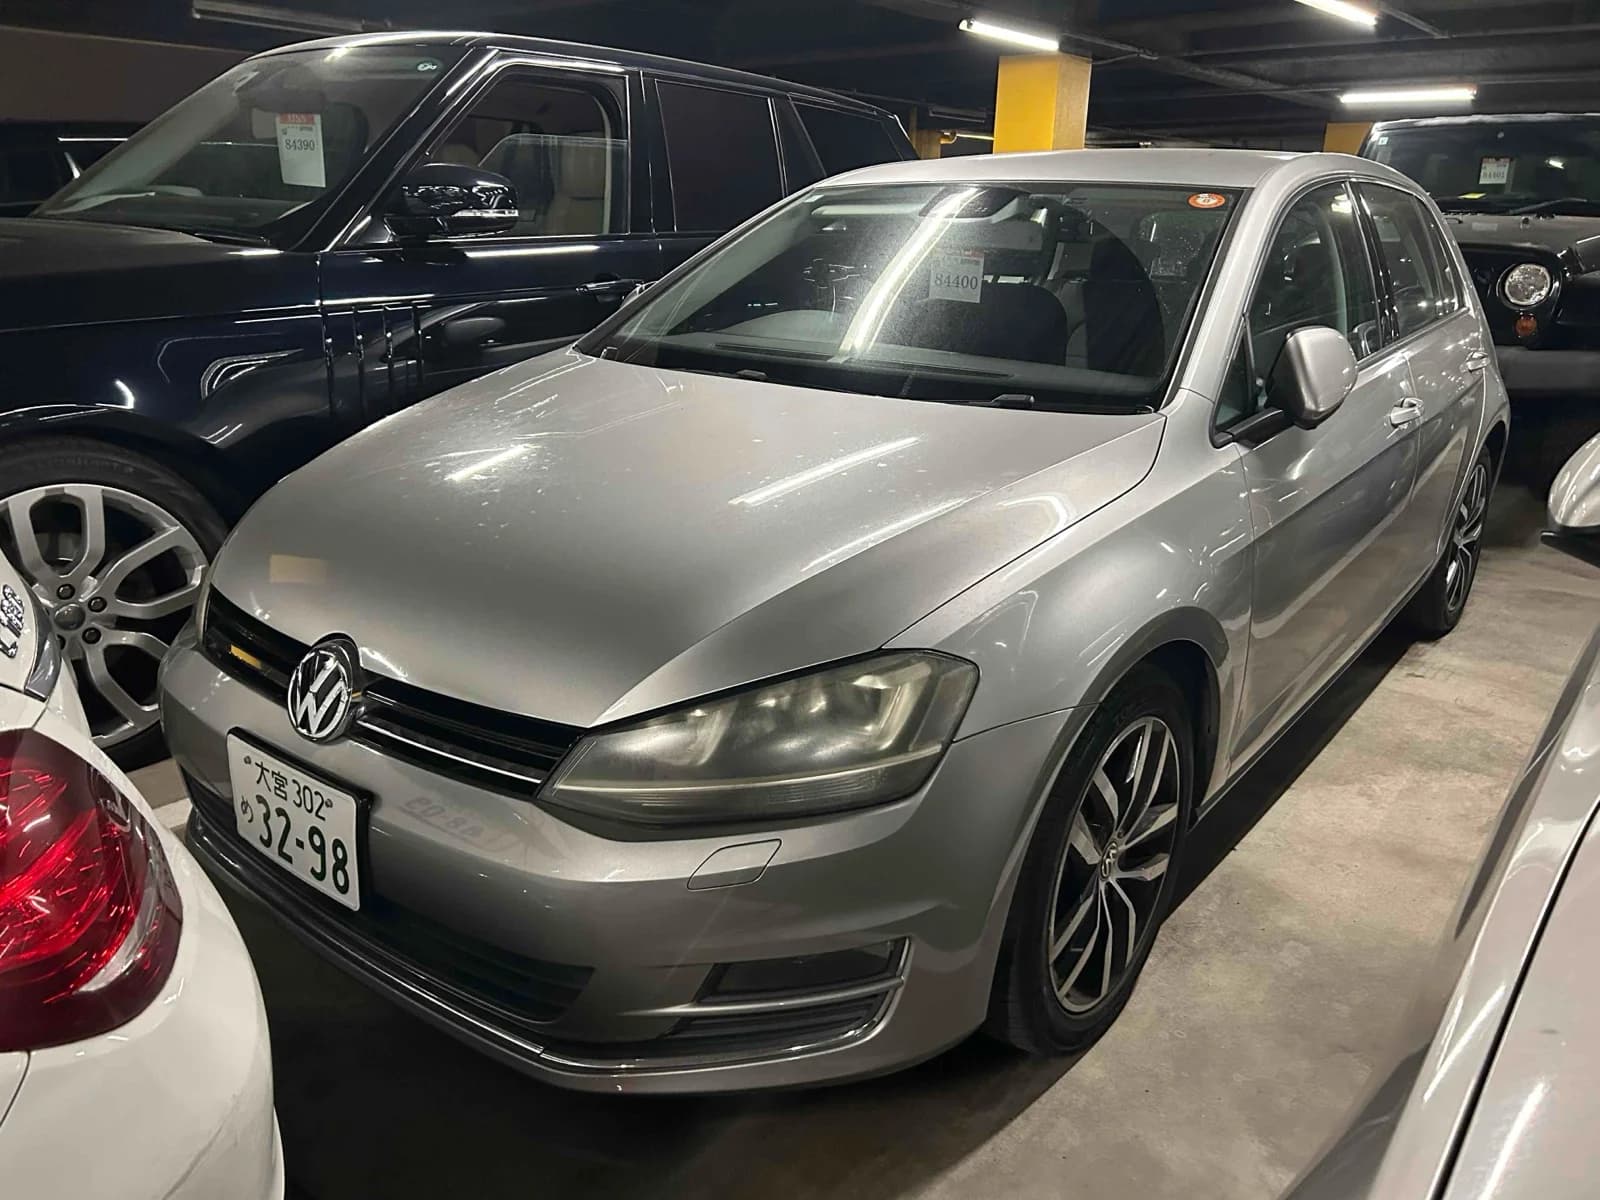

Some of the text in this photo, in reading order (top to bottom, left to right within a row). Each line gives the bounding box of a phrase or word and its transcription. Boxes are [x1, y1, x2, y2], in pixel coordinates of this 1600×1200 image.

[284, 138, 316, 152] 84390
[935, 271, 979, 291] 84400
[254, 761, 327, 822] 大宮 302
[240, 795, 254, 824] め
[255, 794, 350, 895] 32-98
